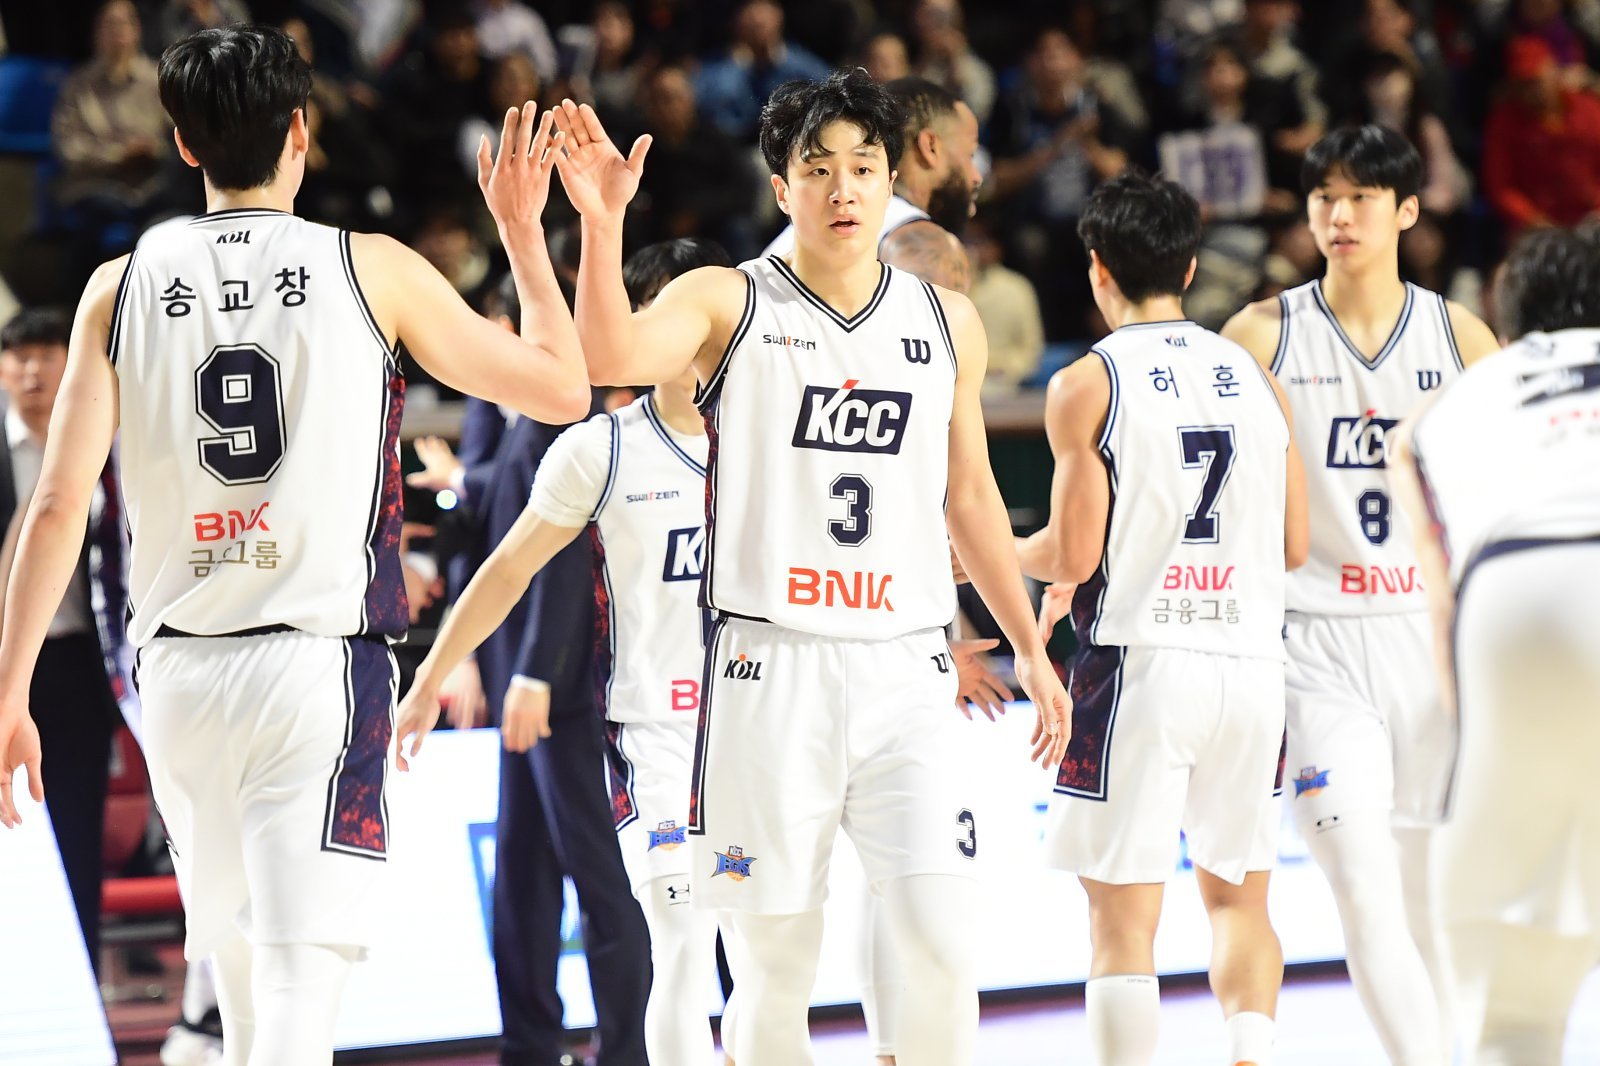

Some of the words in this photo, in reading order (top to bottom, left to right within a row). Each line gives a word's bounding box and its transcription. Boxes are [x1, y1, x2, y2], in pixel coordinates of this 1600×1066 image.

[195, 343, 287, 486] 9
[804, 379, 901, 447] KCC
[827, 472, 873, 547] 3
[1177, 425, 1237, 544] 7
[1356, 488, 1392, 546] 8
[788, 566, 895, 612] BNK
[1163, 565, 1235, 591] BNK
[1152, 598, 1241, 625] 금융그룹
[723, 658, 762, 681] KBL
[956, 807, 977, 860] 3
